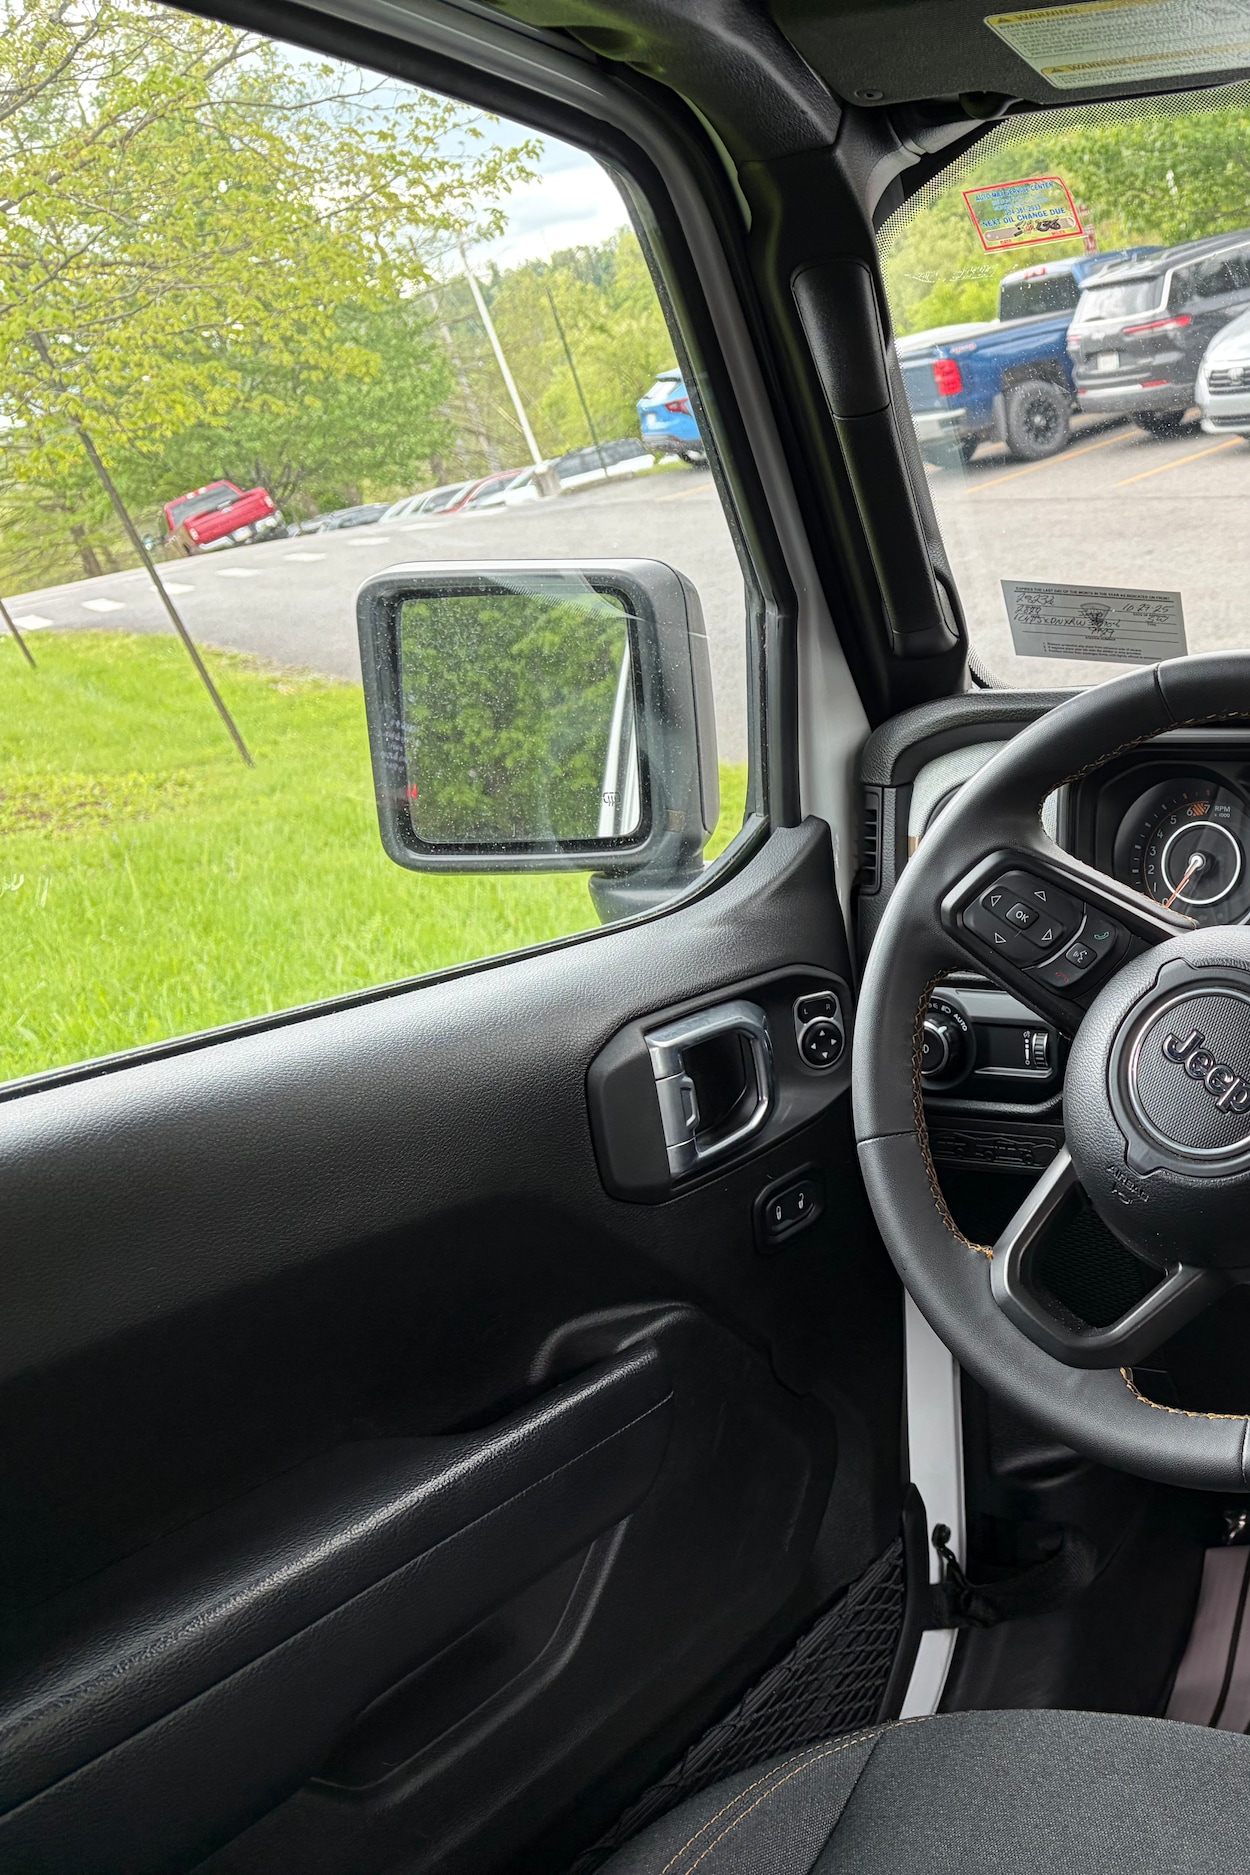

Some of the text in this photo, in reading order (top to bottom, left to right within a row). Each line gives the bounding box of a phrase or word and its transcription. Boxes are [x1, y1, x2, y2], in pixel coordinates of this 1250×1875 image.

[1014, 8, 1079, 21] WARNING
[982, 219, 1001, 227] NEXT
[1017, 212, 1047, 221] CHANGE
[1050, 207, 1066, 215] DUE
[1170, 816, 1177, 825] 5
[1157, 830, 1163, 838] 4
[1149, 846, 1156, 856] 3
[1148, 865, 1155, 874] 2
[1014, 910, 1030, 923] OK
[953, 1013, 968, 1032] AUTO
